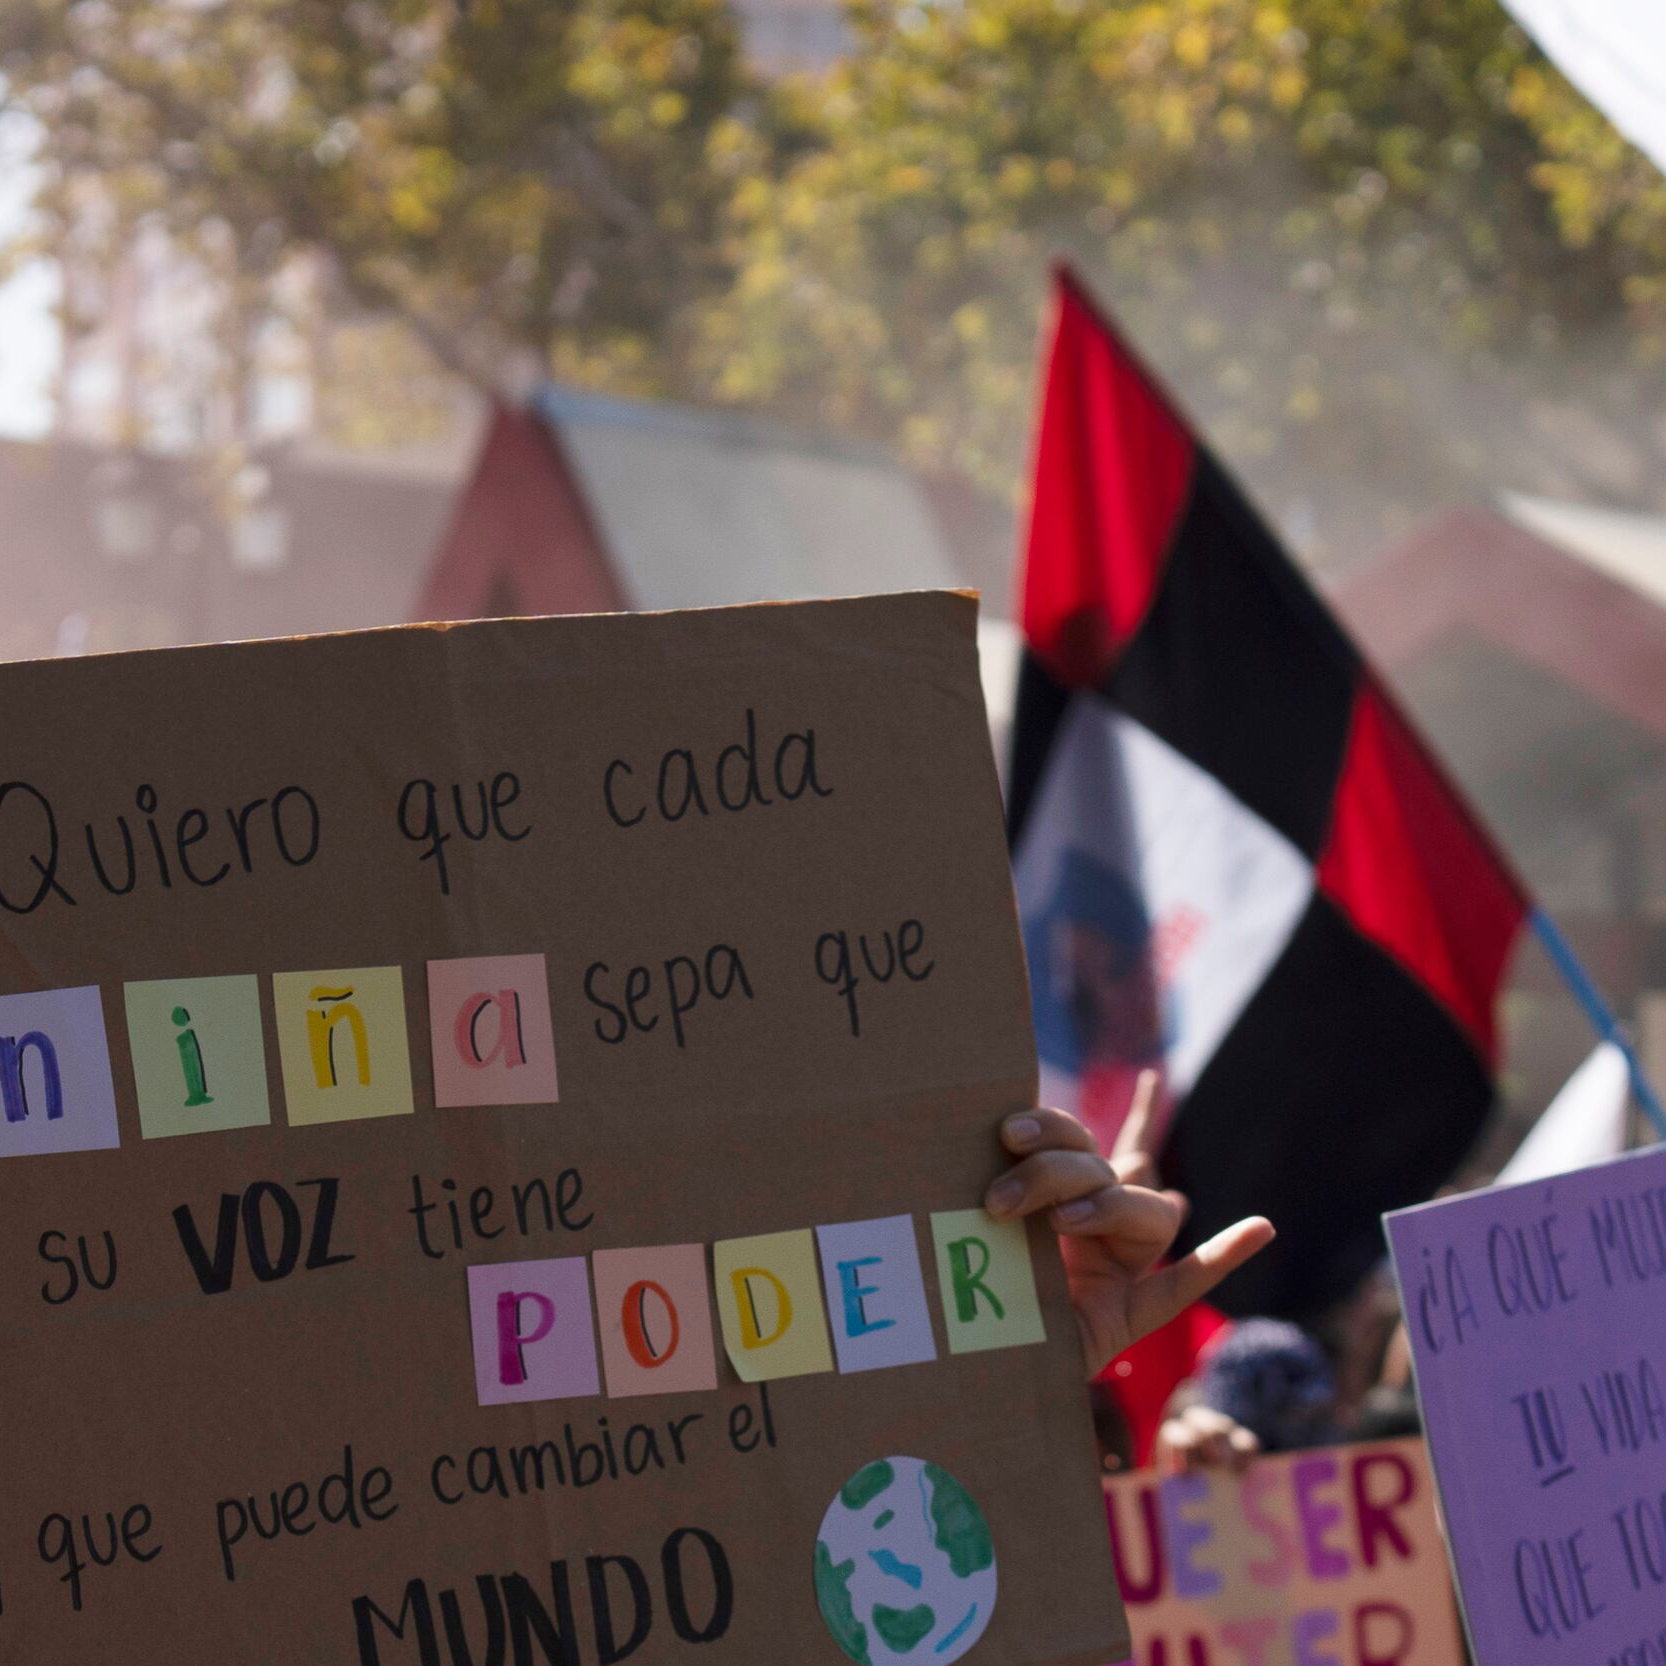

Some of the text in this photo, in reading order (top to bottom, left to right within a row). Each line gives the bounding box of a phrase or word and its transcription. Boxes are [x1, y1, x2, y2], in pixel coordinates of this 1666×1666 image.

[395, 762, 534, 896] que
[602, 707, 835, 830] cada
[581, 940, 756, 1048] sepa
[813, 915, 935, 1037] que
[37, 1165, 597, 1305] su VOZ tiene
[494, 1233, 1006, 1388] PODER
[37, 1498, 164, 1612] que
[216, 1443, 401, 1581] puede
[428, 1412, 704, 1505] cambiar
[728, 1379, 776, 1452] el
[1103, 1450, 1415, 1605] UE SER
[1515, 1528, 1606, 1640] QUE
